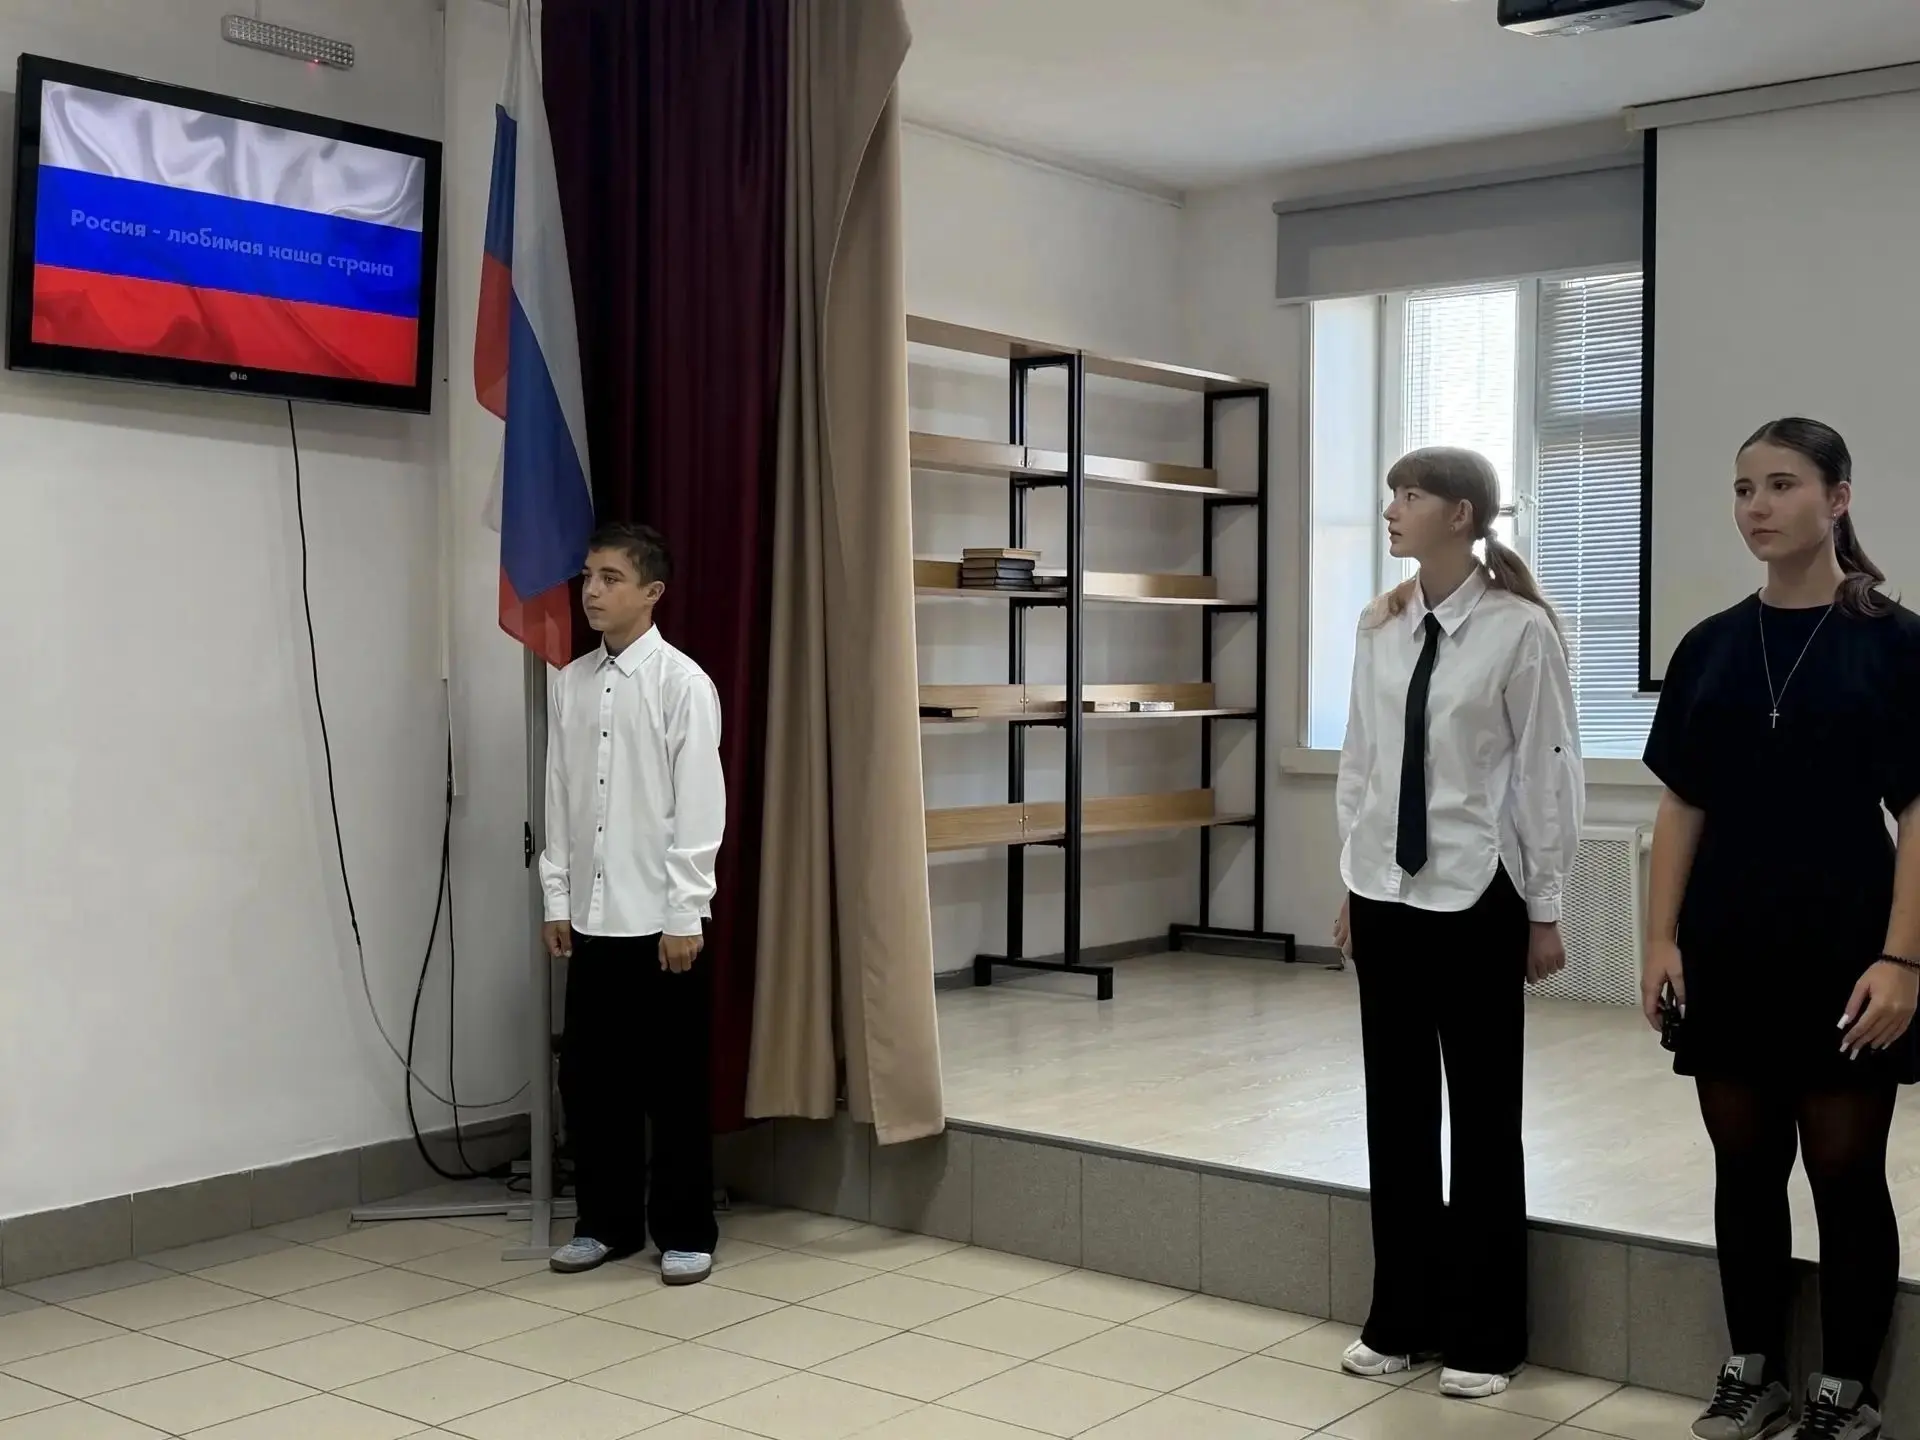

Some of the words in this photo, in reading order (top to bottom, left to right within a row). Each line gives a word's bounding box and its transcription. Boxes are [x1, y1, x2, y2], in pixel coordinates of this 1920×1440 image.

[70, 209, 146, 237] Россия
[167, 227, 263, 256] любимая
[269, 245, 322, 265] наша
[327, 255, 394, 277] страна
